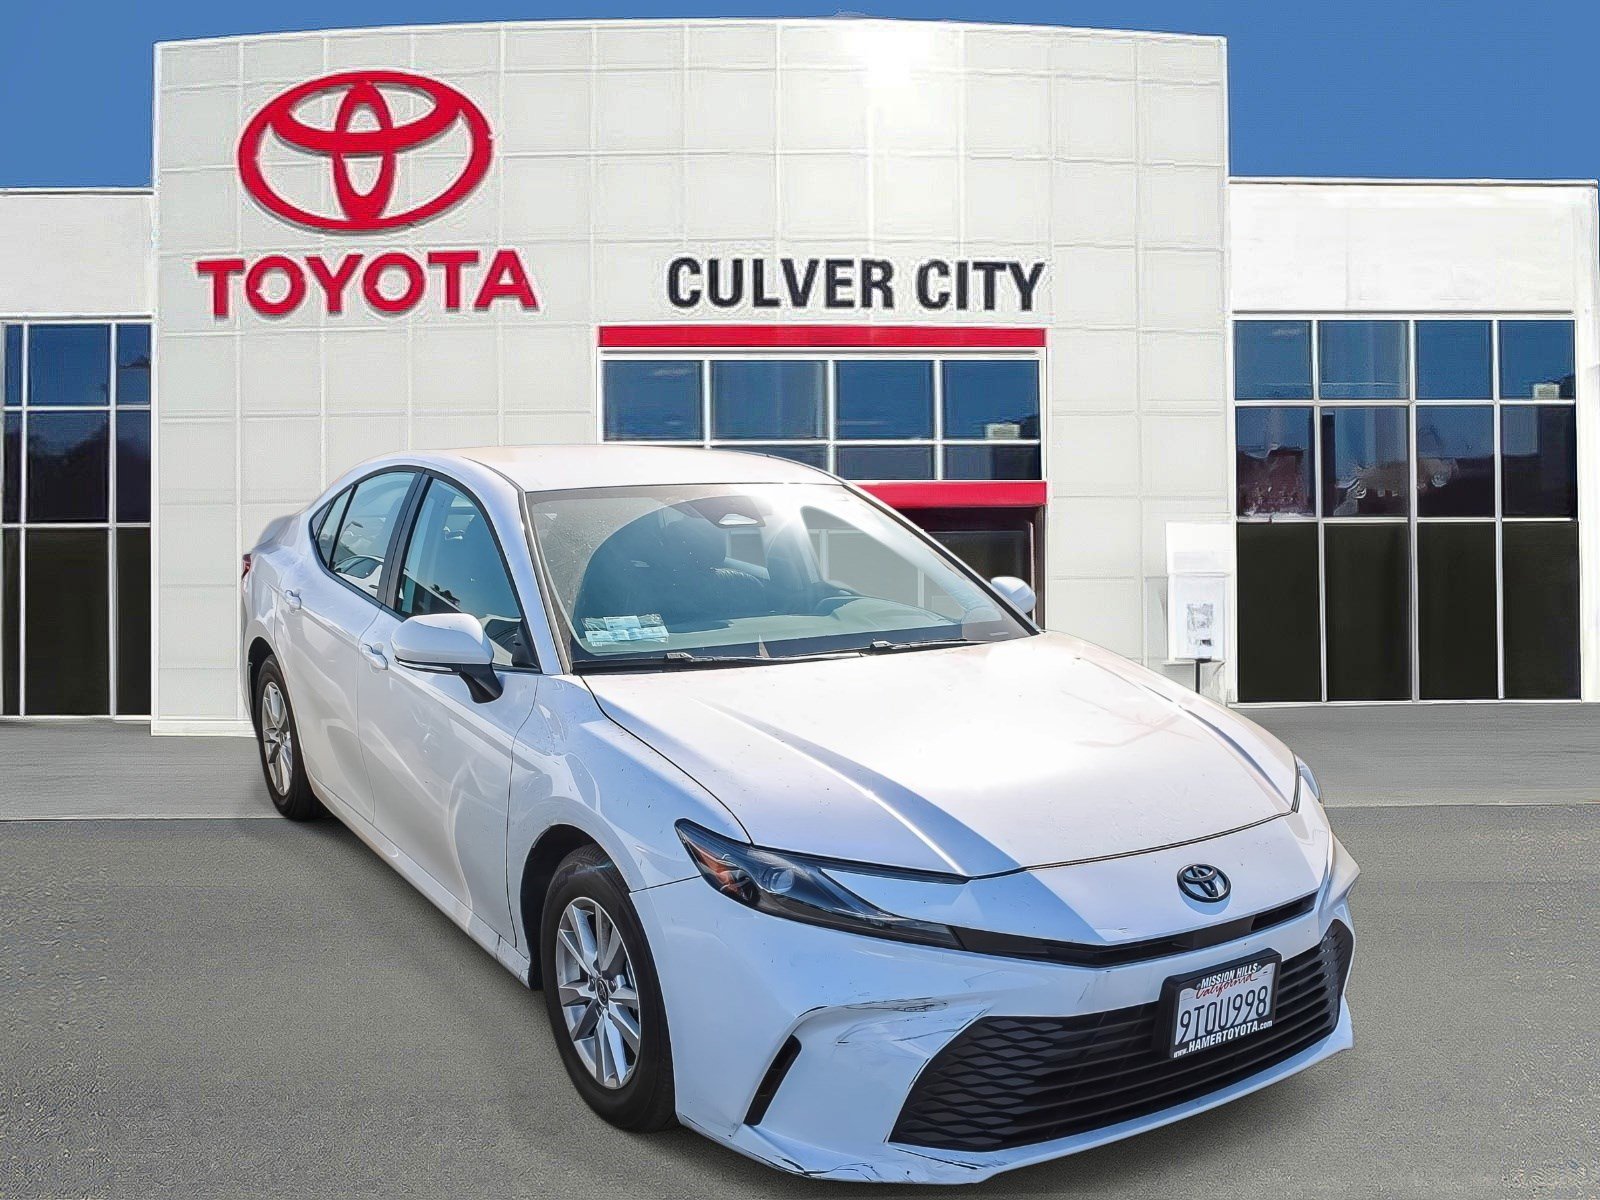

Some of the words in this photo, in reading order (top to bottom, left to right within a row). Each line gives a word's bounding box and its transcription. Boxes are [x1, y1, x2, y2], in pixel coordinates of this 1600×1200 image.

[196, 249, 539, 319] TOYOTA
[667, 256, 895, 309] CULVER
[916, 259, 1046, 312] CITY
[1200, 969, 1236, 989] MISSION
[1236, 962, 1259, 978] HILLS
[1173, 1020, 1273, 1059] www.HAMERTOYOTA.com
